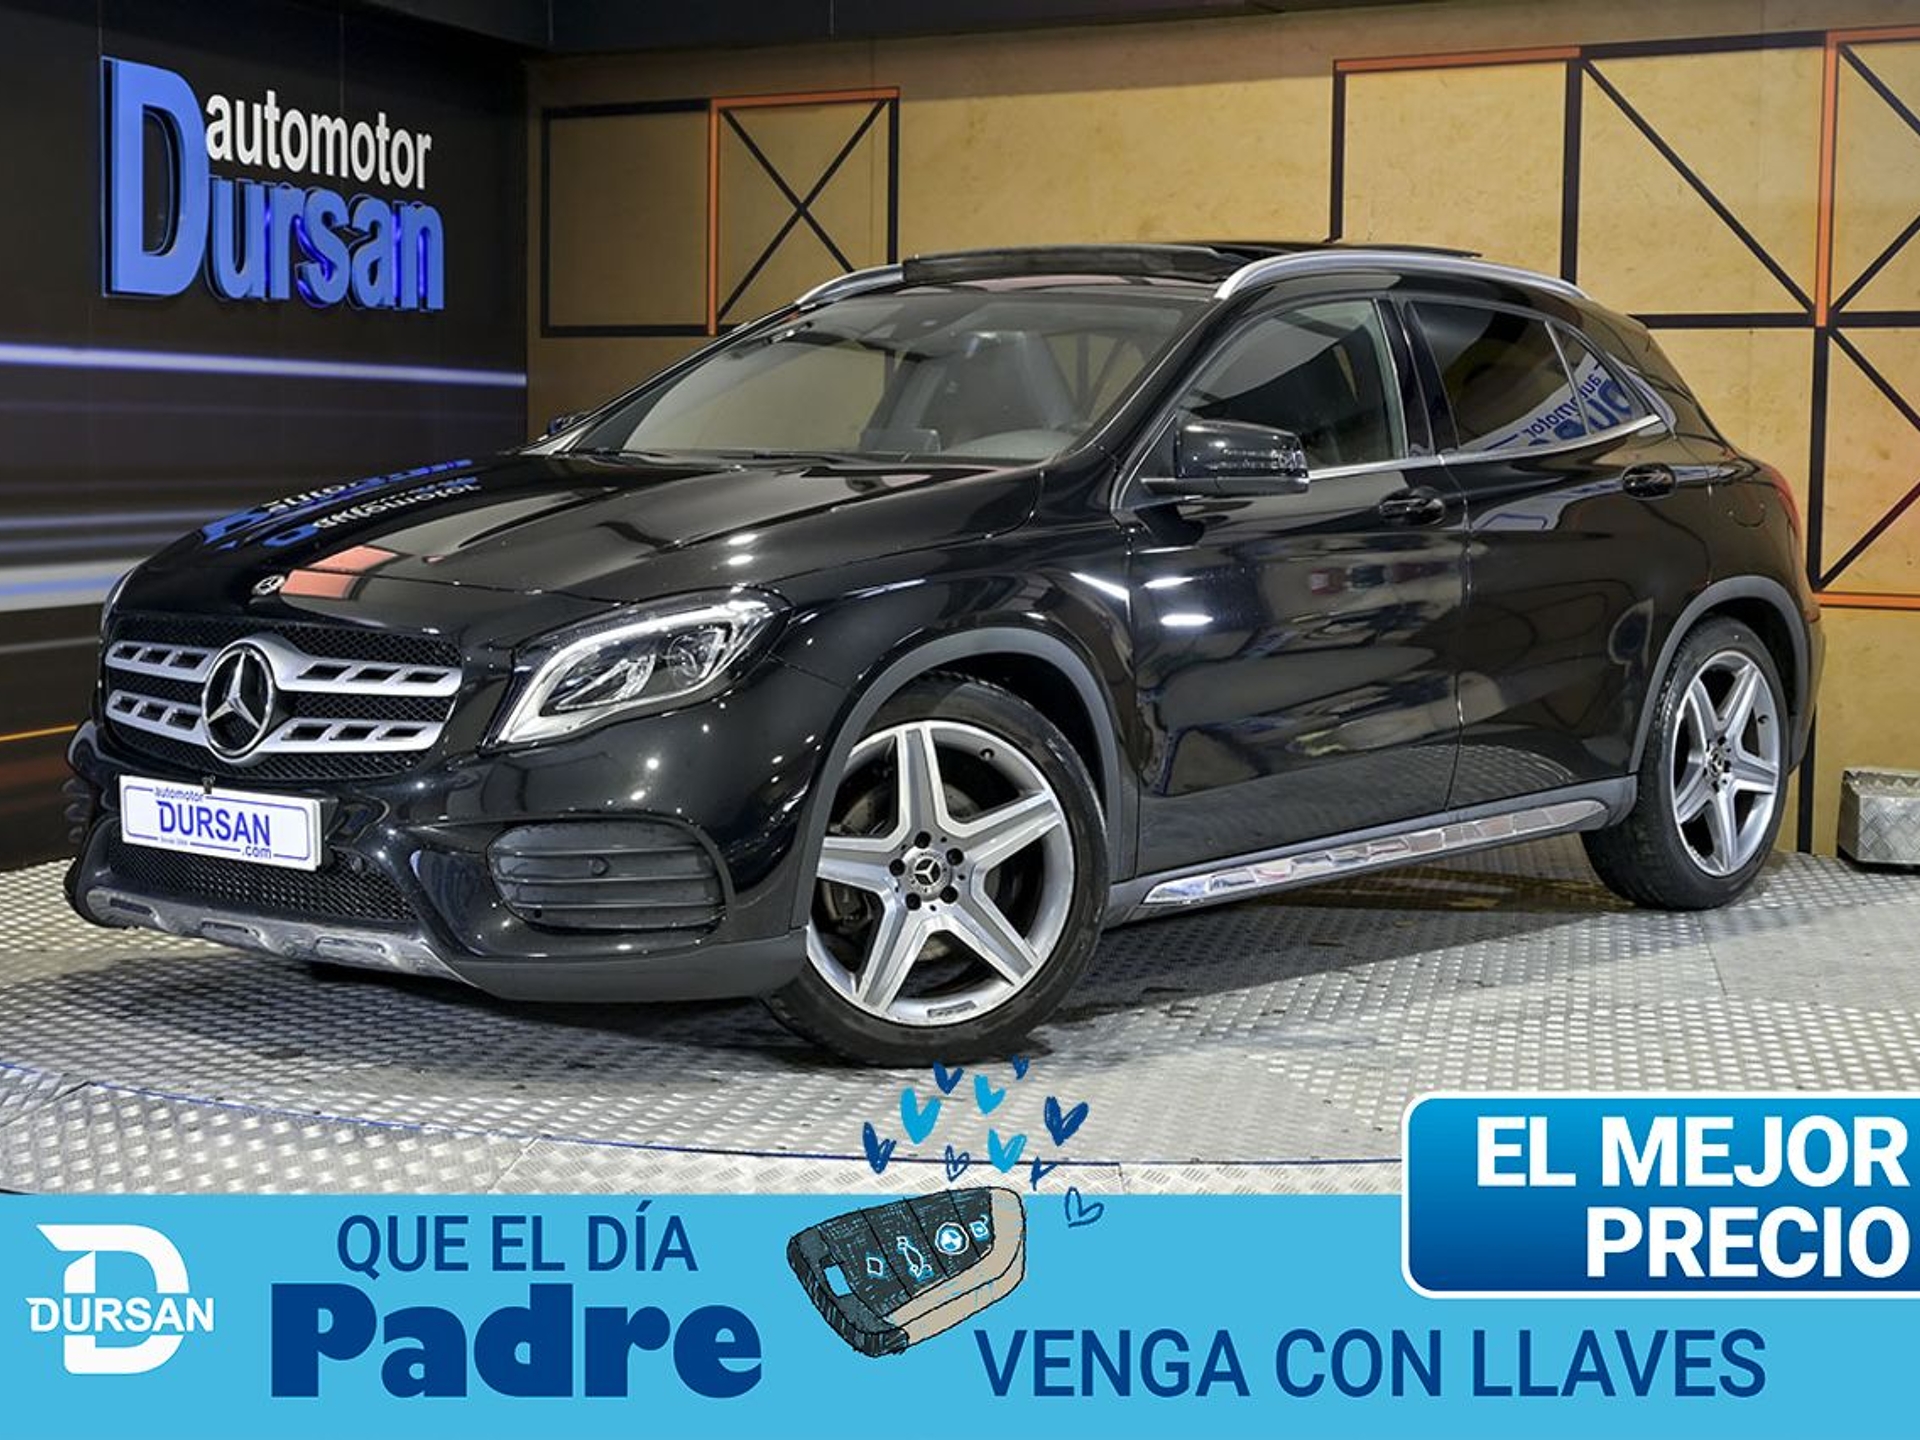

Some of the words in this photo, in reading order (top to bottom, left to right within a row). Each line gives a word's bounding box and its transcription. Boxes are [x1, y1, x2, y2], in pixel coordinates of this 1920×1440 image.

[205, 90, 432, 190] automotor
[101, 55, 445, 311] Dursan
[156, 800, 271, 846] DURSAN
[241, 844, 272, 859] .com
